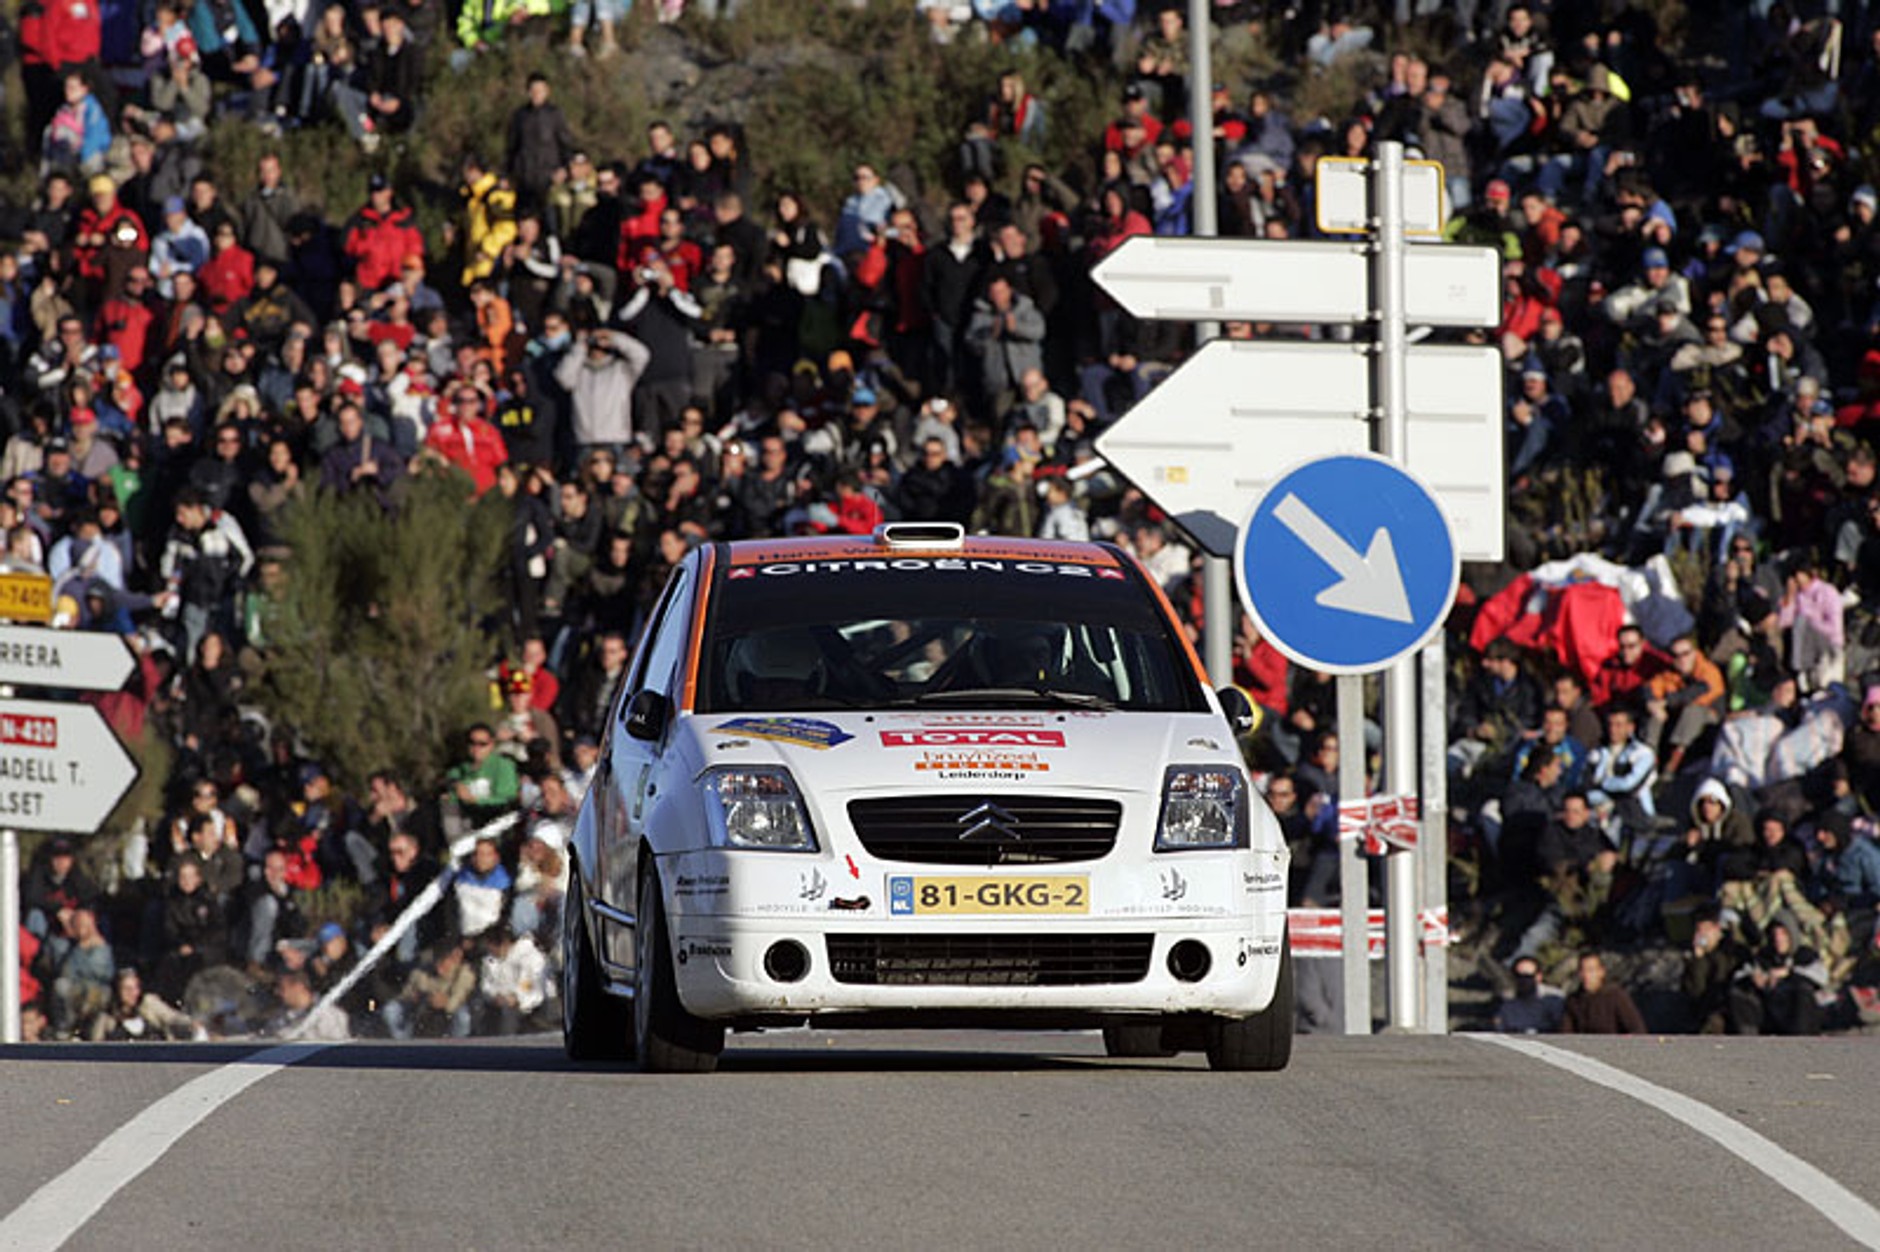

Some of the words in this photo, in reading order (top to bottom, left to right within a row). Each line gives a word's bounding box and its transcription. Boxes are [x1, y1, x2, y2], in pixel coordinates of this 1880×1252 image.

[760, 557, 1003, 575] CITROËN
[1015, 563, 1092, 577] C2
[3, 719, 54, 742] N-420
[888, 731, 1057, 745] TOTAL
[920, 883, 1083, 907] 81-GKG-2
[893, 901, 910, 911] NL
